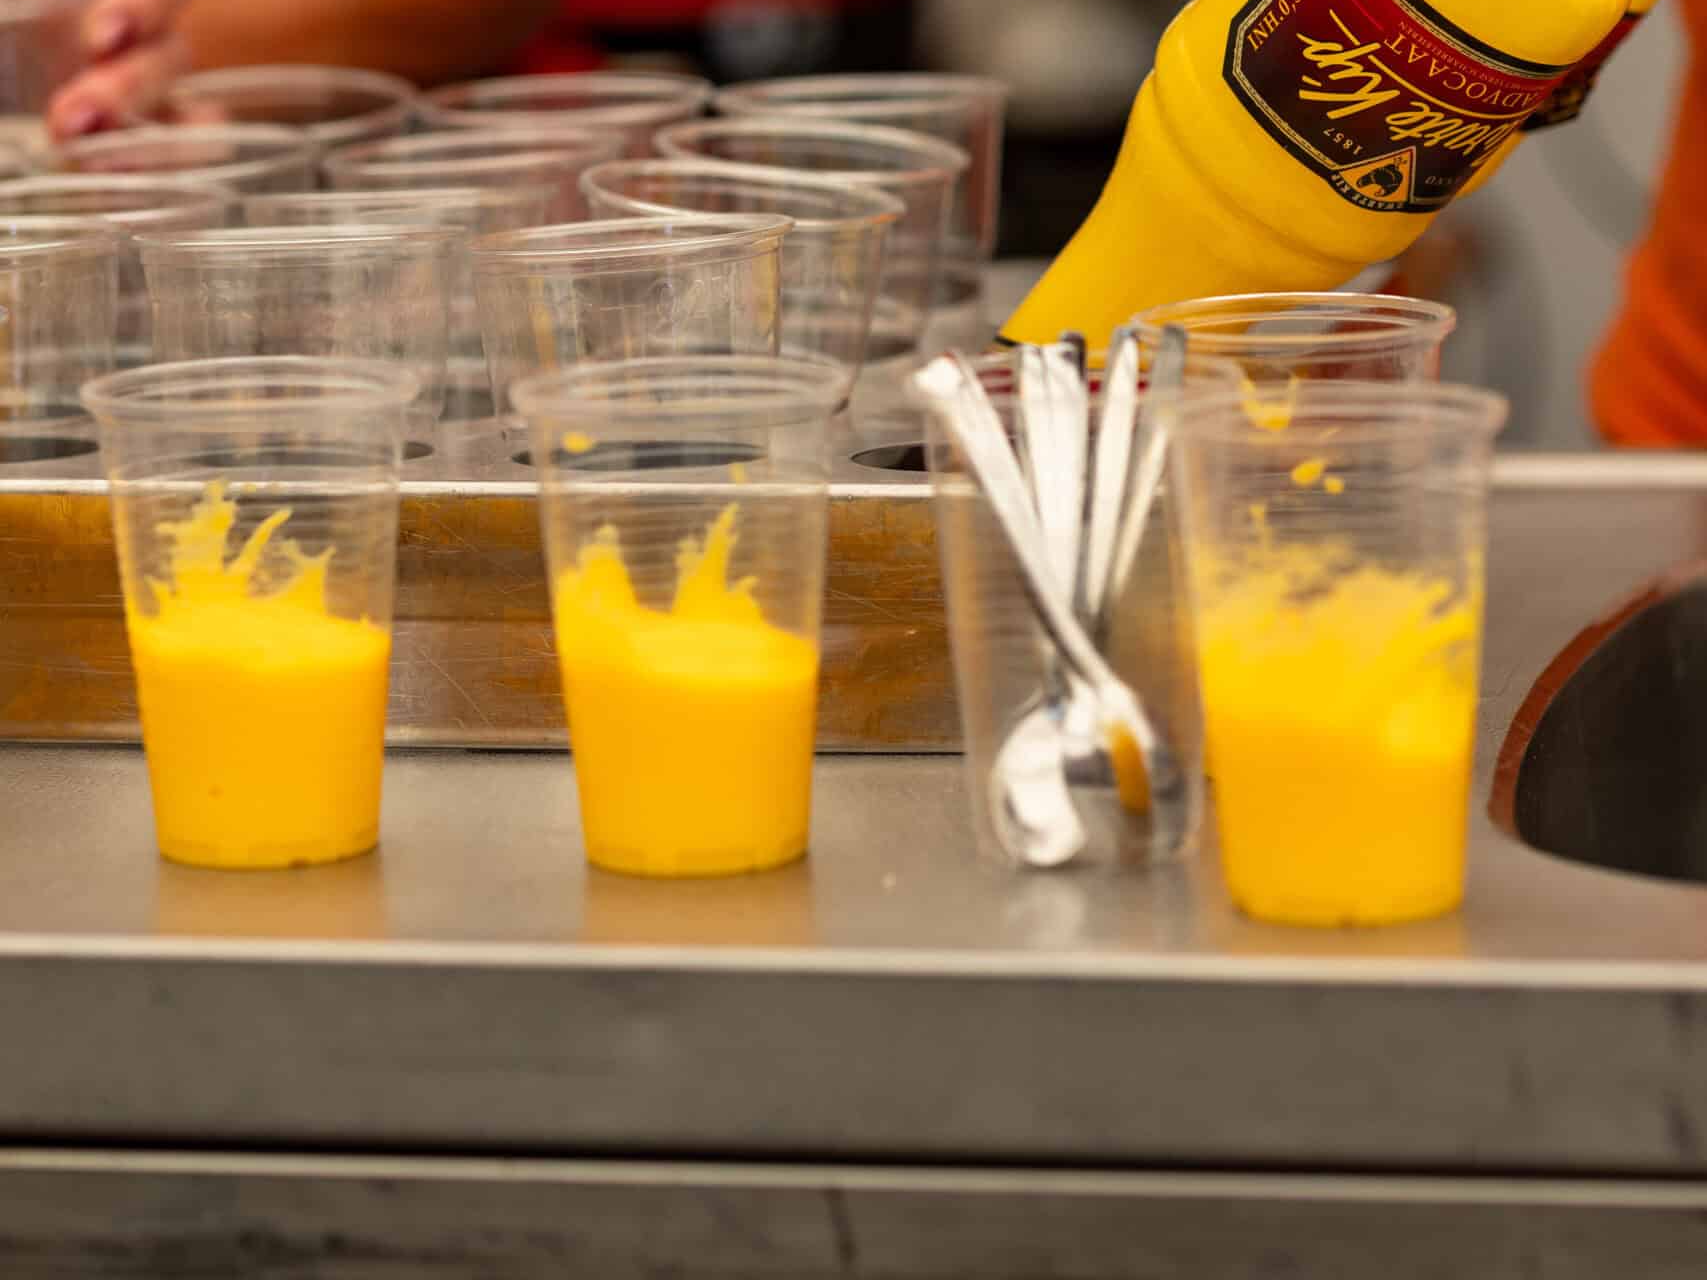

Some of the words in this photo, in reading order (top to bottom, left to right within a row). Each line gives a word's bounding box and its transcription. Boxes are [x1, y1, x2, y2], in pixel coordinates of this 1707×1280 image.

[1296, 32, 1400, 119] Kip
[1384, 34, 1540, 108] ADVOCAAT
[1323, 127, 1363, 155] 1857
